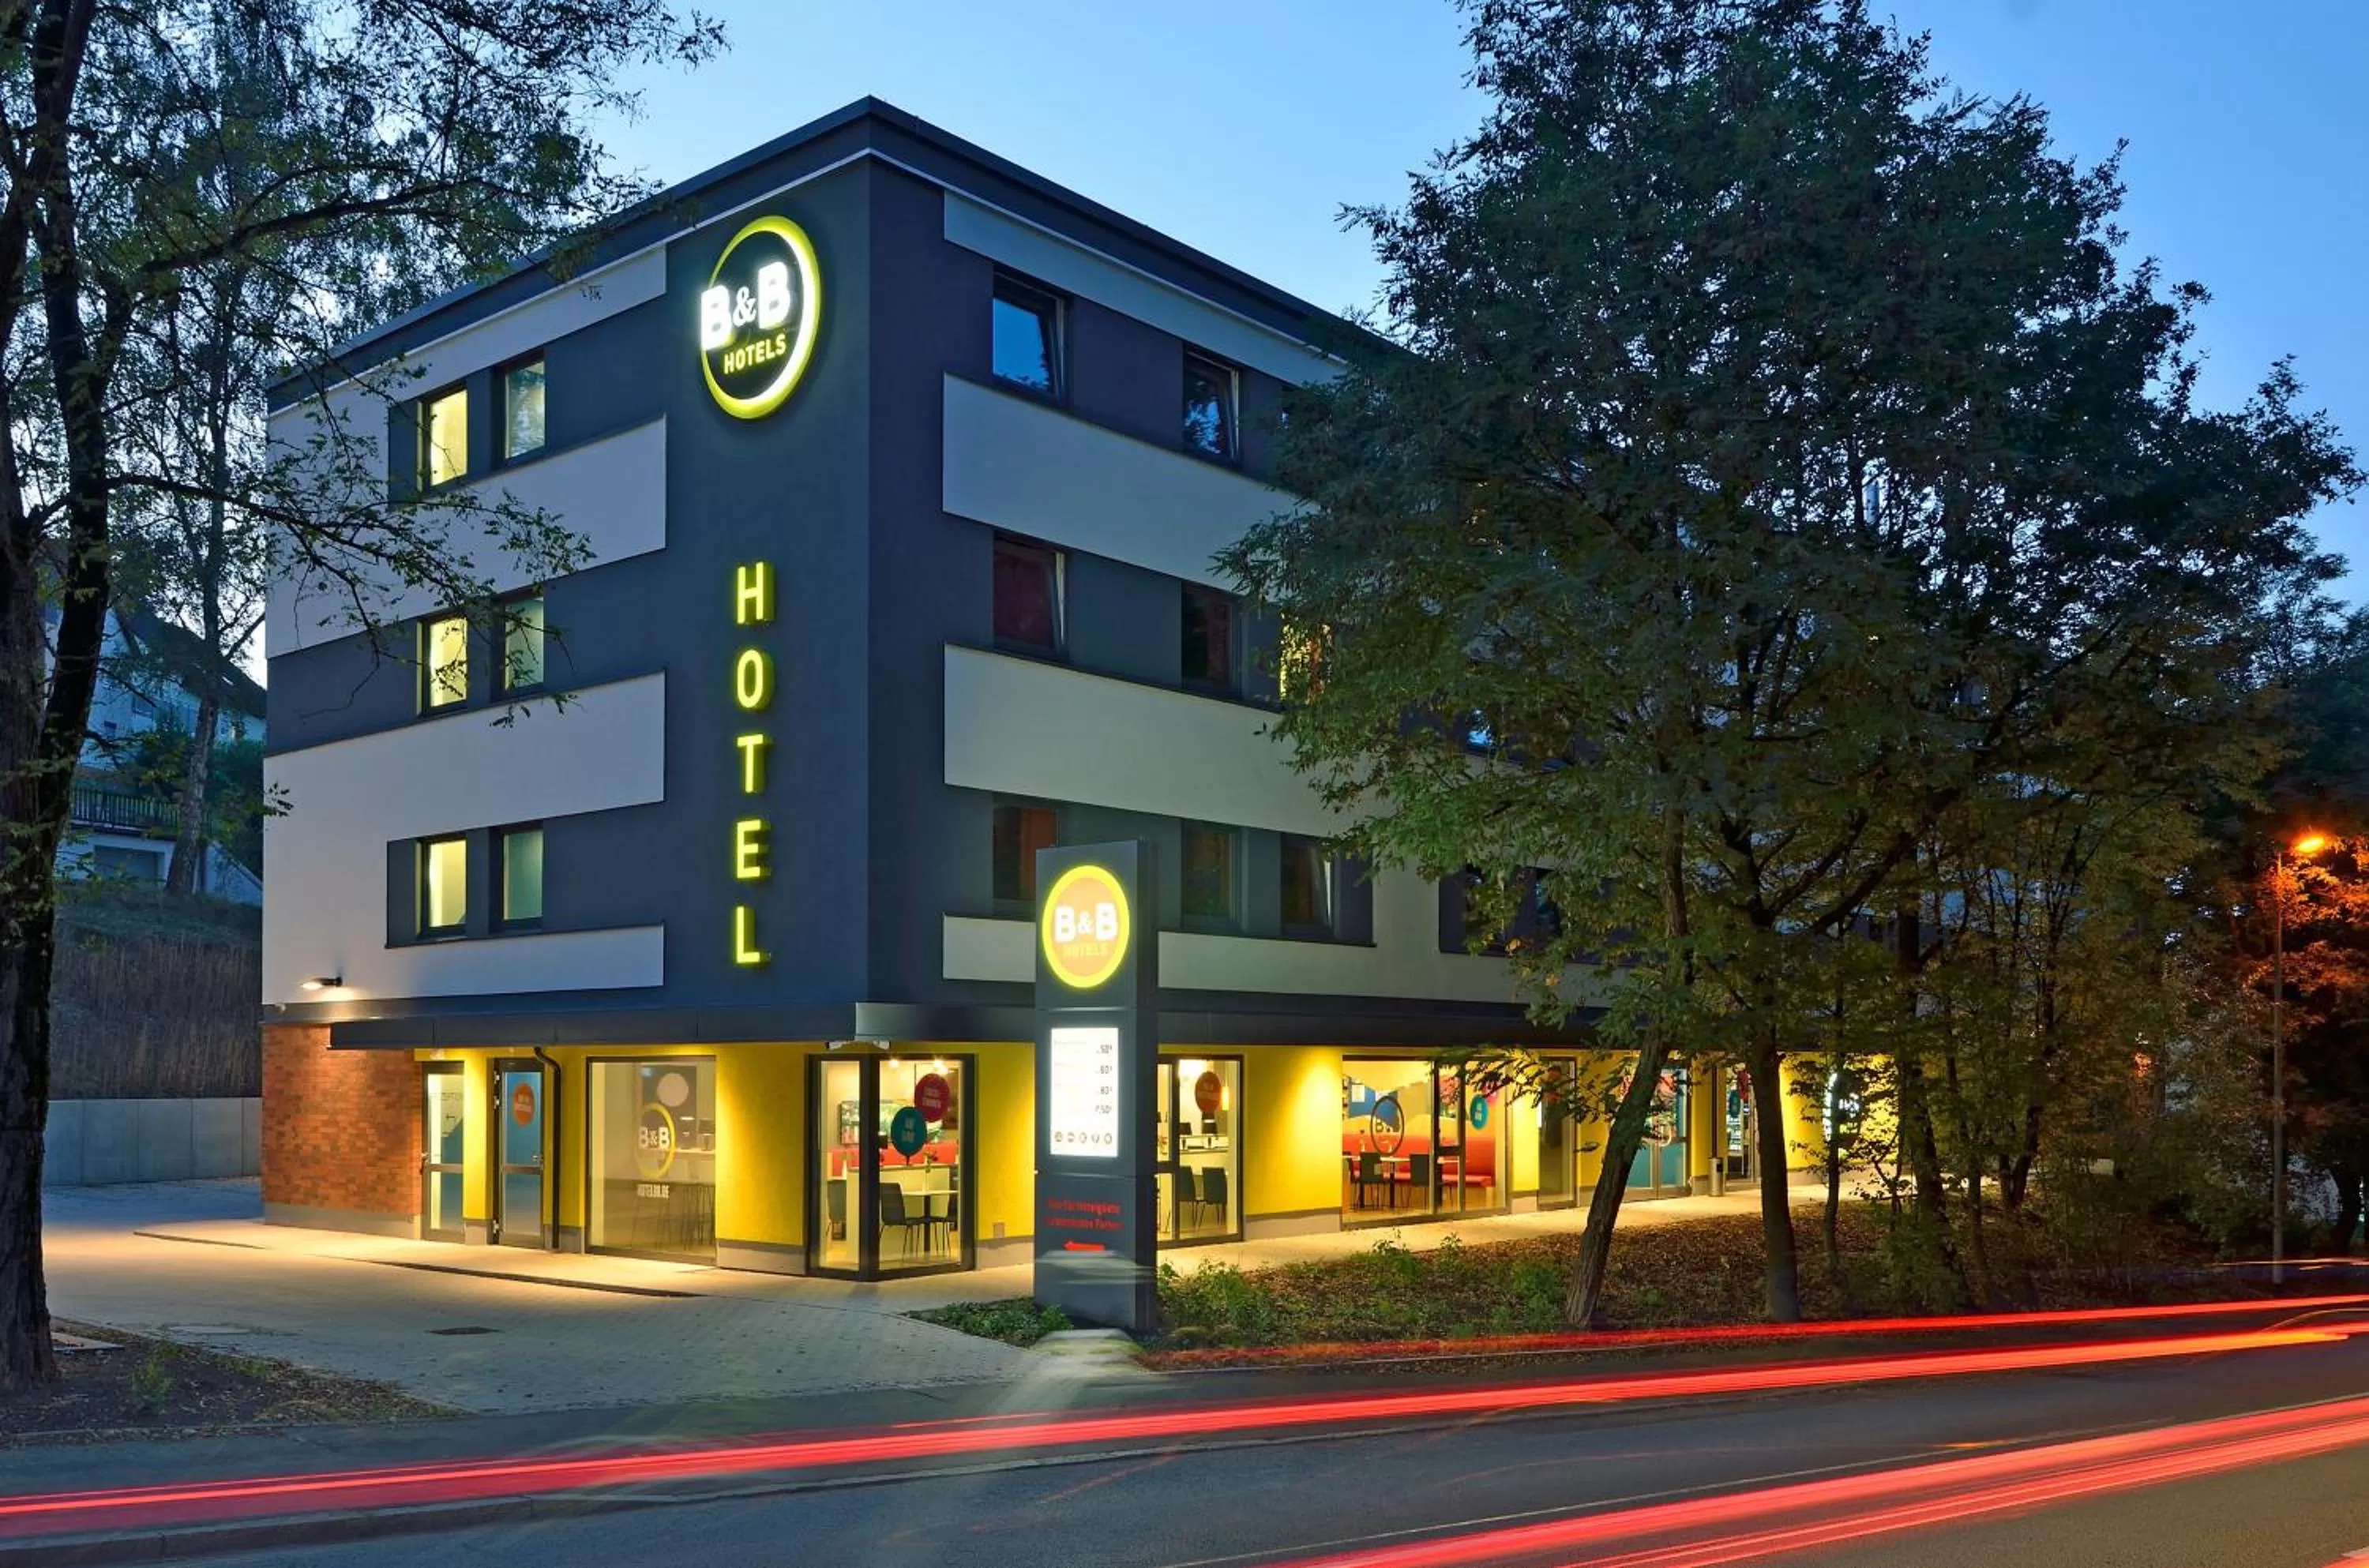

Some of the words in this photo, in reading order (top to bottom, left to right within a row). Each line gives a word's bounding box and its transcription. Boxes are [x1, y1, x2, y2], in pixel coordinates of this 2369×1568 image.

[700, 261, 790, 351] B&B
[723, 332, 787, 374] HOTELS
[735, 560, 772, 965] HOTEL
[1054, 902, 1118, 943] B&B
[638, 1126, 670, 1150] B&B
